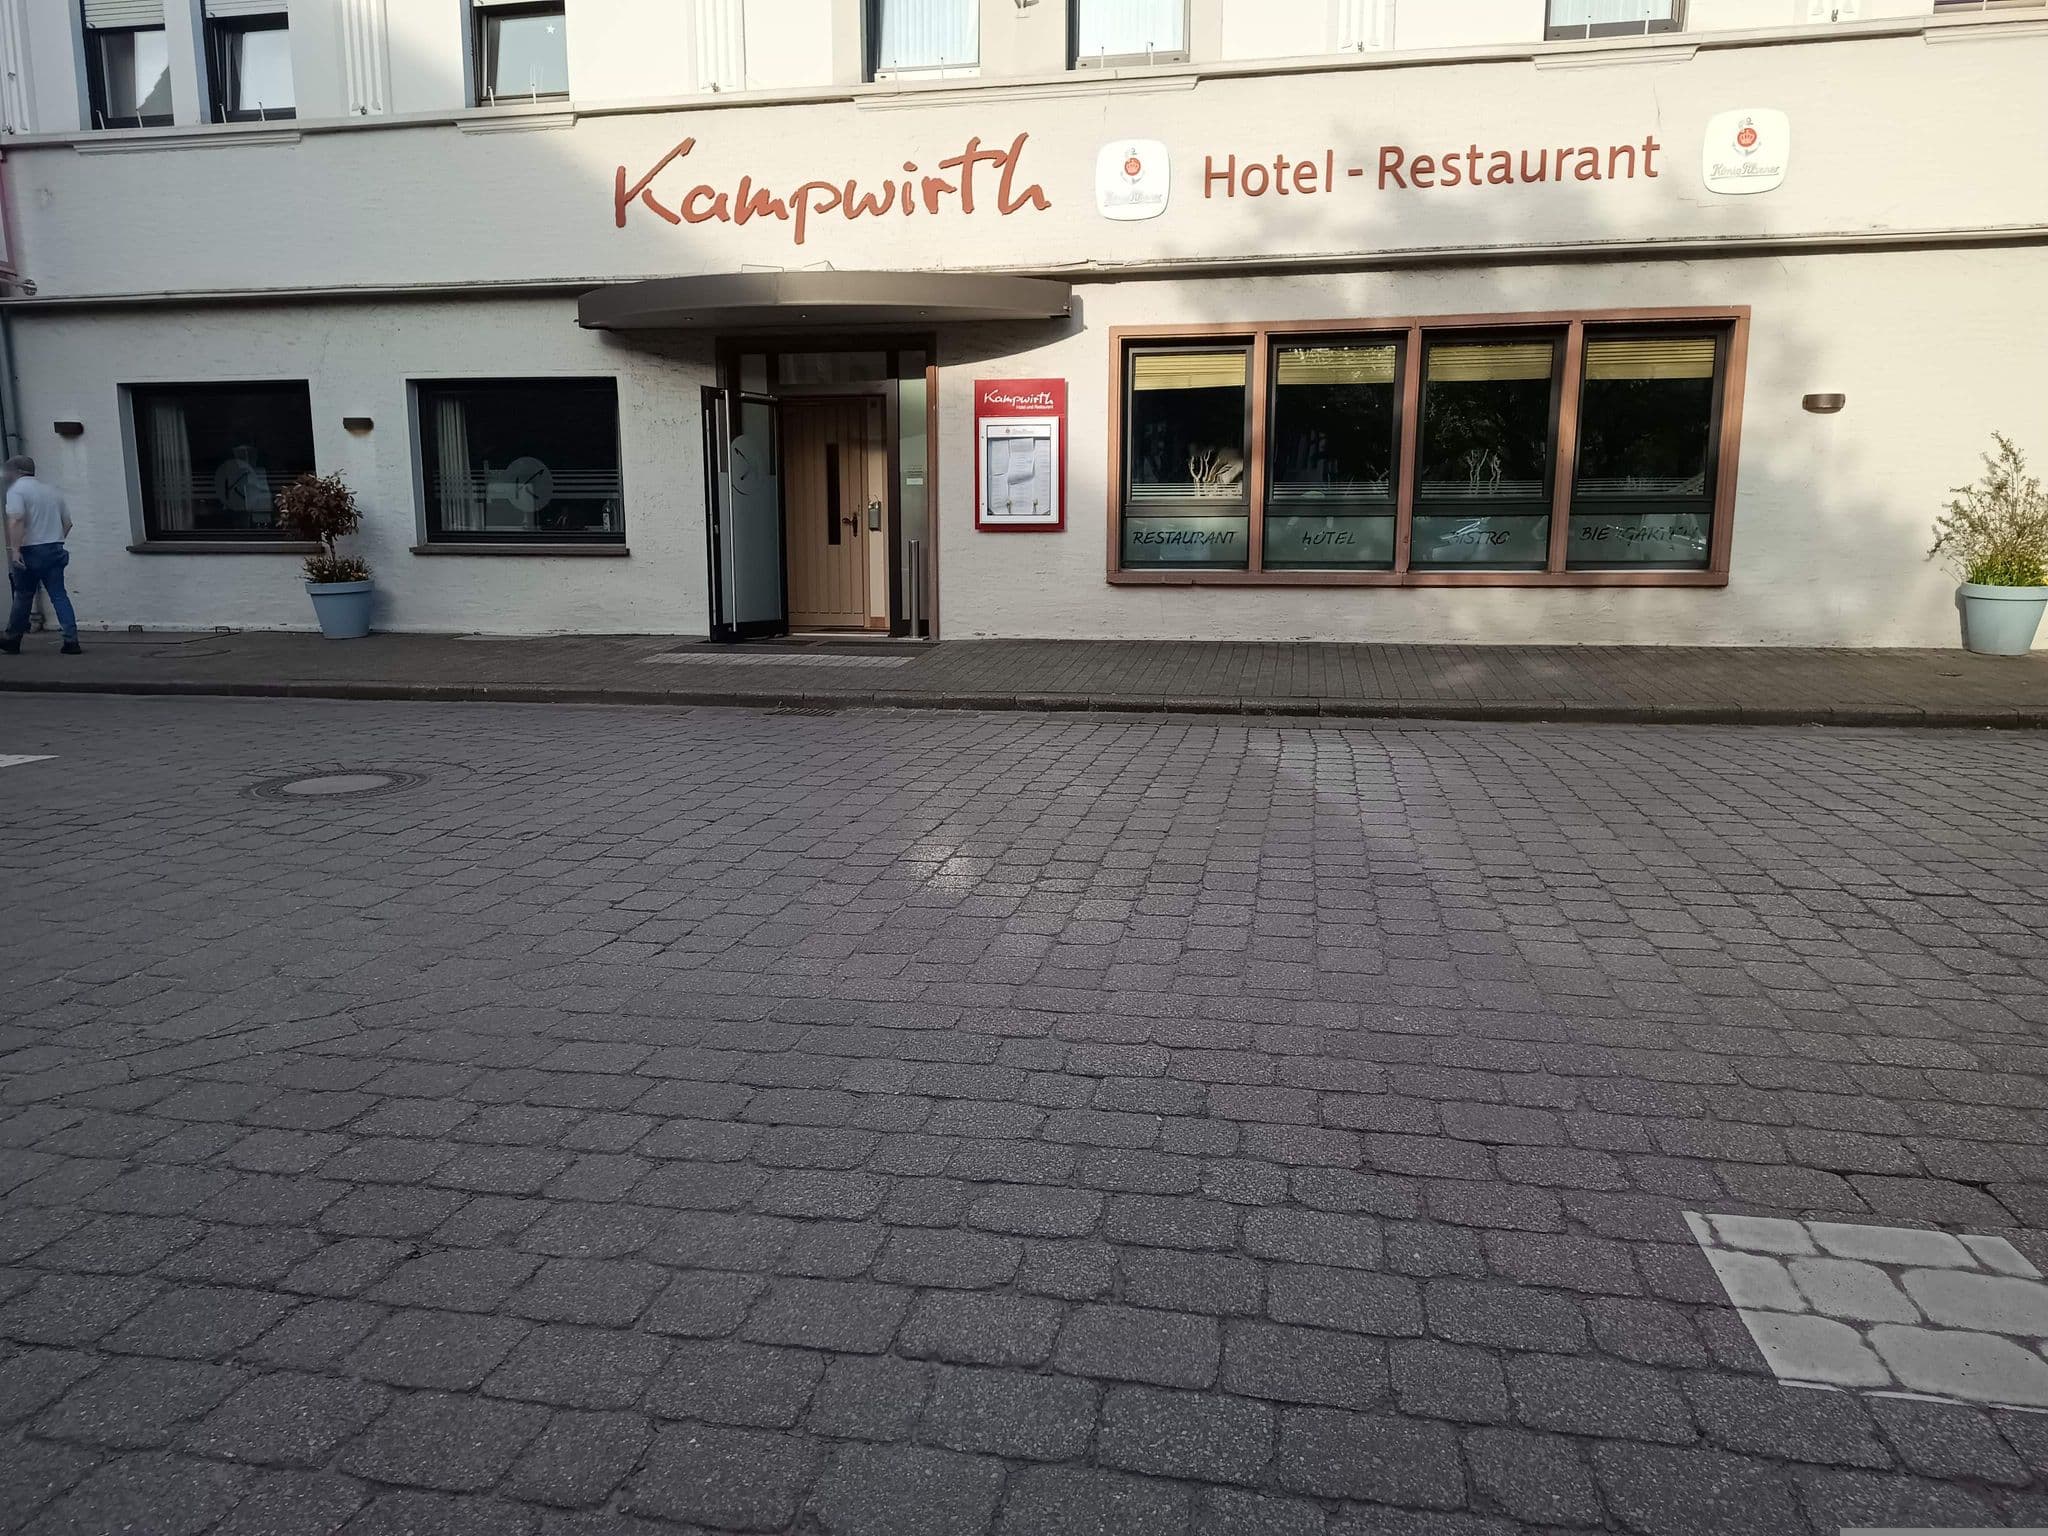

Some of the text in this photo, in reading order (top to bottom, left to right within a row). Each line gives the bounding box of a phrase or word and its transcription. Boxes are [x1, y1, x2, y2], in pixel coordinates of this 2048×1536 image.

[1204, 136, 1660, 199] Hotel - Restaurant
[616, 132, 1051, 246] Kampwirth
[983, 389, 1054, 406] Kampwirth
[1132, 531, 1238, 545] RESTAURANT
[1448, 531, 1511, 545] ISTRO
